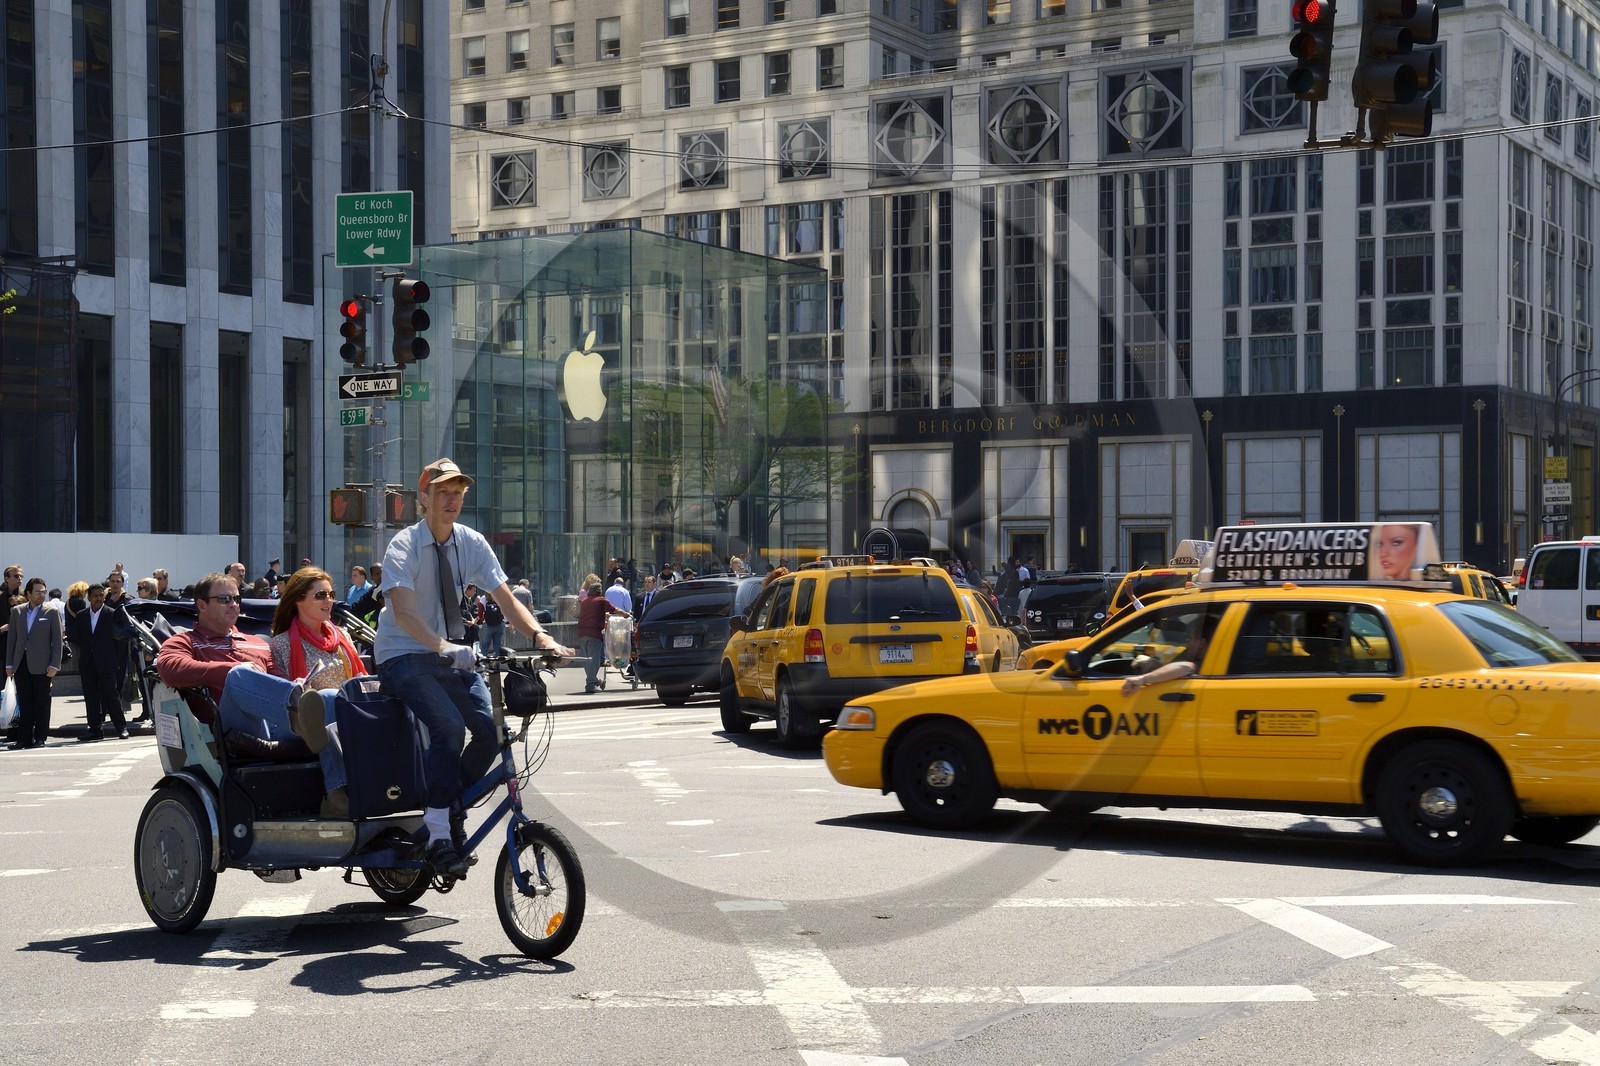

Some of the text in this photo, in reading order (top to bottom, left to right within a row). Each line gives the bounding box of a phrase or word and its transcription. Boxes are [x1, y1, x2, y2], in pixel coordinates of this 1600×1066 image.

[355, 198, 393, 210] Ed Koch
[340, 213, 408, 226] Queensboro Br
[346, 228, 402, 240] Lower Rdwy
[350, 379, 393, 392] ONE WAY
[404, 384, 413, 398] 5
[341, 409, 364, 425] E 59 ST
[919, 412, 1136, 434] BERGDORF GOODMAN
[1218, 528, 1370, 552] FLASHDANCERS
[1325, 551, 1365, 567] CLUB
[1227, 568, 1352, 581] 52ND & BROADWAY
[1038, 705, 1159, 740] NYC TAXI
